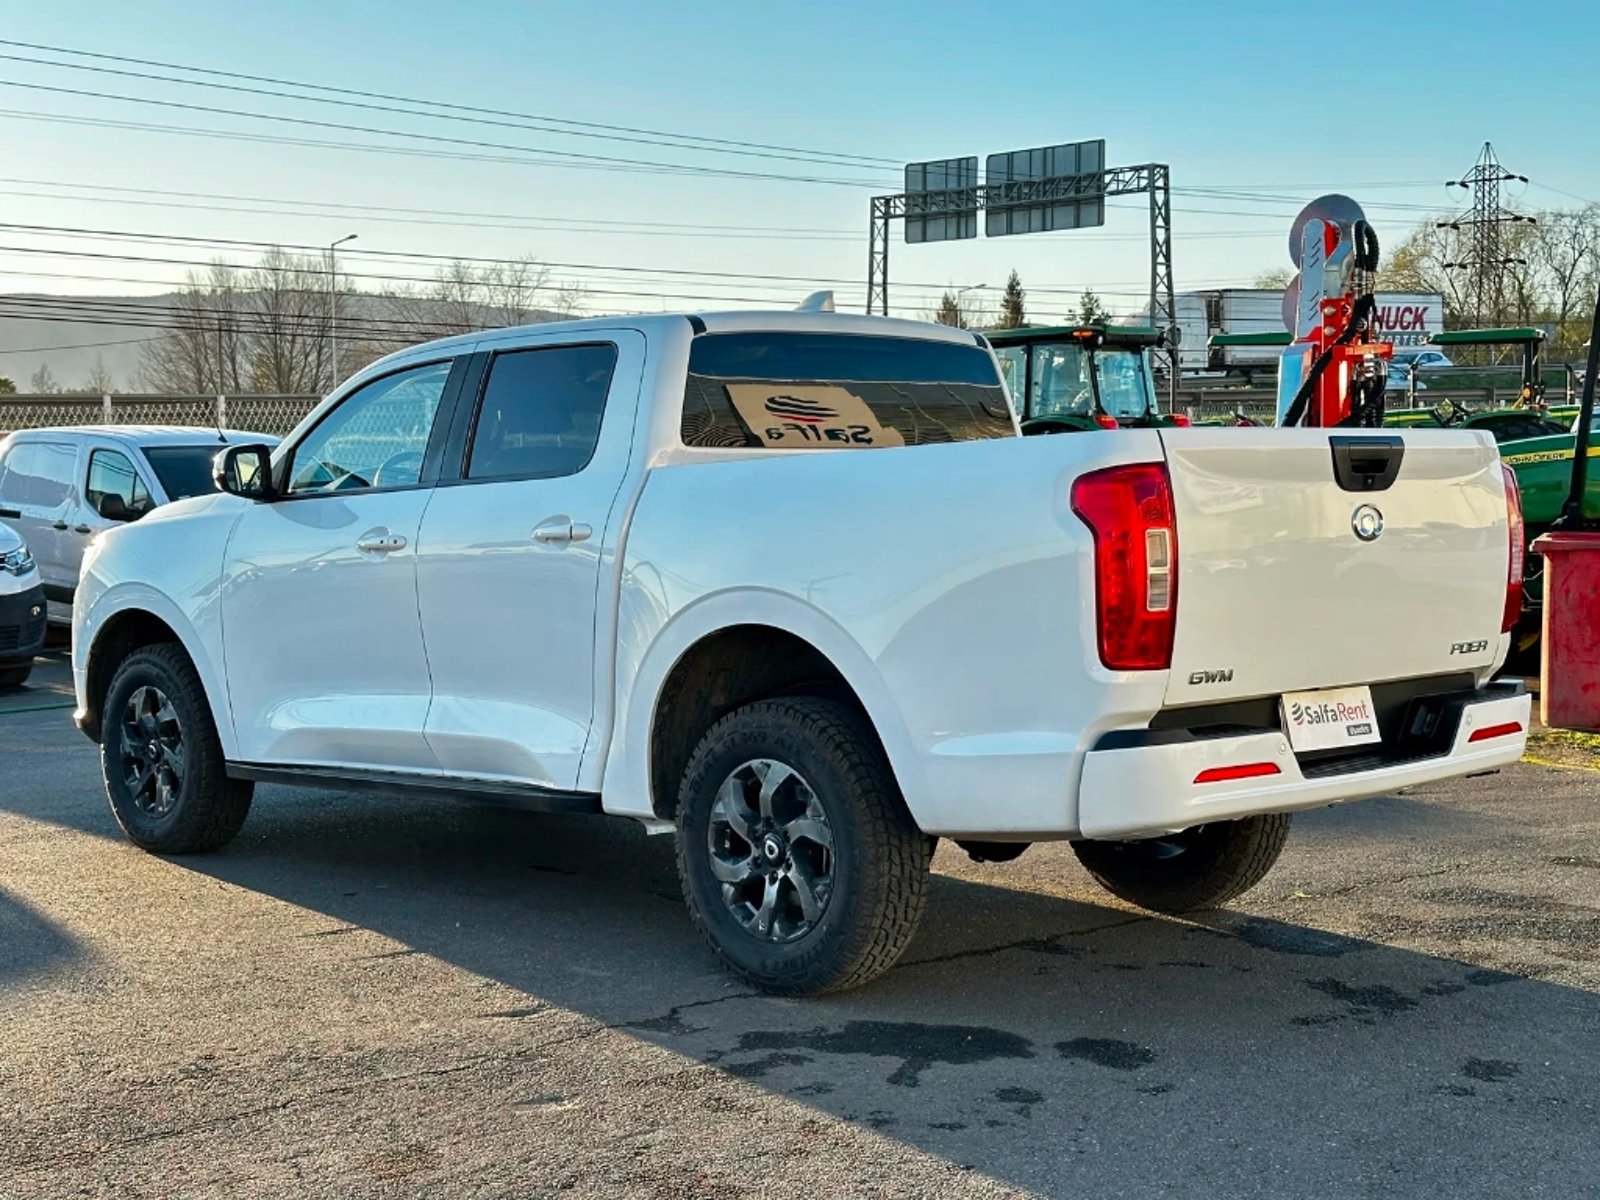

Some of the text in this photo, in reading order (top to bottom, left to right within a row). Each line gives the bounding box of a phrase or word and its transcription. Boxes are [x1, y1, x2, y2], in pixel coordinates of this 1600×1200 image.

[1508, 452, 1565, 464] JOHN DEERE
[1450, 640, 1488, 655] POER
[1188, 669, 1233, 685] GWM
[1304, 700, 1369, 725] SalfaRent
